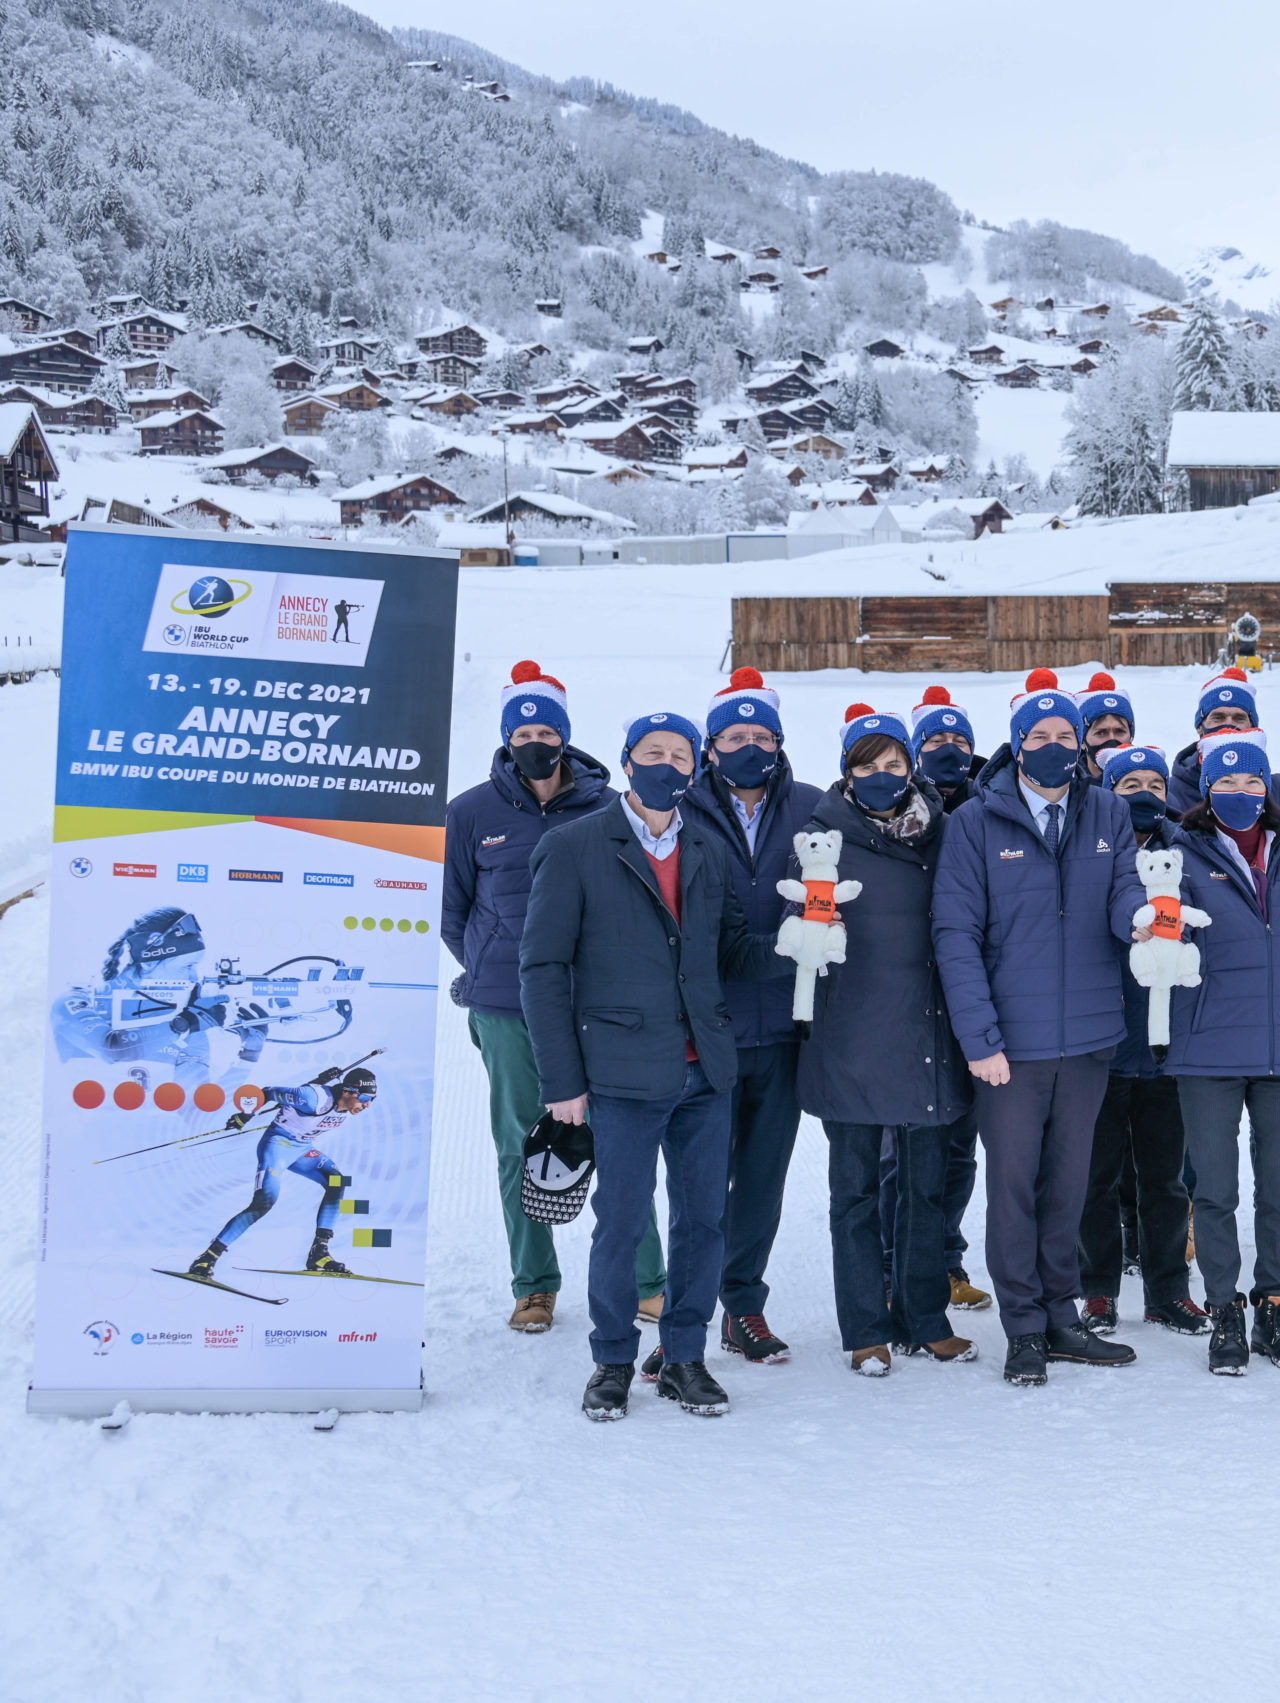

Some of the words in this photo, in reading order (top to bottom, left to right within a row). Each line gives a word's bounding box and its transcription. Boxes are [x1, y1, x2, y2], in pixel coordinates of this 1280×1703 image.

[279, 595, 328, 613] ANNECY
[279, 612, 289, 624] LE
[293, 612, 327, 627] GRAND
[194, 626, 210, 635] IBU
[278, 626, 327, 642] BORNAND
[193, 632, 227, 643] WORLD
[191, 639, 235, 649] BIATHLON
[148, 674, 186, 692] 13.
[210, 678, 247, 696] 19.
[254, 681, 303, 700] DEC
[308, 684, 370, 704] 2021
[177, 706, 341, 740] ANNECY
[88, 730, 125, 752] LE
[131, 732, 420, 771] GRAND-BORNAND
[70, 762, 119, 776] BMW
[122, 765, 153, 778] IBU
[157, 767, 218, 782] COUPE
[222, 771, 249, 784] DU
[252, 773, 319, 788] MONDE
[323, 777, 346, 789] DE
[349, 779, 435, 795] BIATHLON
[180, 866, 206, 877] DKB
[306, 875, 352, 885] DECATHLON
[382, 881, 427, 890] BAUHAUS
[160, 1332, 192, 1342] Région
[205, 1328, 235, 1337] haute
[205, 1336, 238, 1344] savoie
[265, 1337, 297, 1345] SPORT
